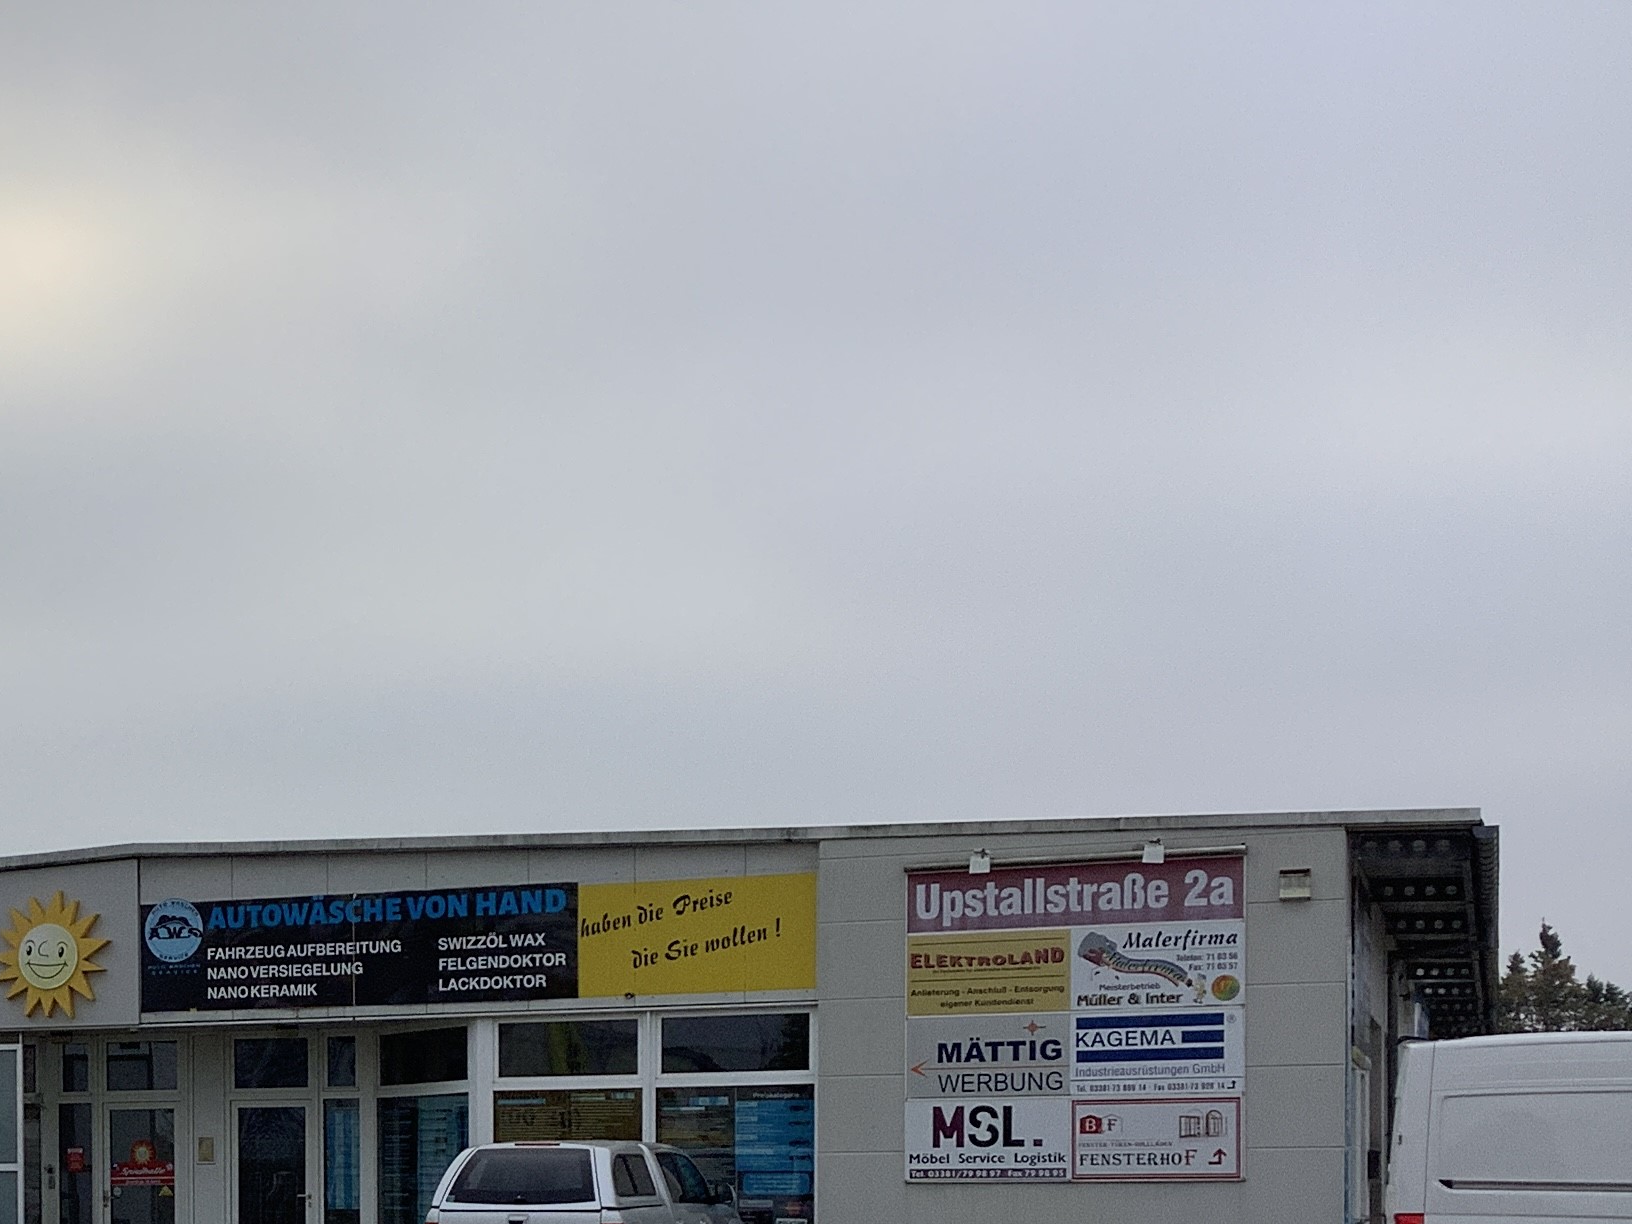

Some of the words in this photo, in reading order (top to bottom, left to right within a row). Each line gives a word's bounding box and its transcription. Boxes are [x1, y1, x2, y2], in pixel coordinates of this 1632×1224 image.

[915, 872, 1169, 927] Upstallstraße
[1184, 869, 1235, 908] 2a
[206, 895, 402, 930] AUTOWÄSCHE
[407, 893, 470, 921] VON
[475, 888, 568, 917] HAND
[580, 911, 632, 938] haben
[636, 904, 664, 925] die
[672, 888, 733, 917] Preise
[438, 932, 508, 951] SWIZZÖL
[509, 932, 547, 948] WAX
[631, 948, 660, 969] die
[664, 940, 699, 962] Sie
[704, 926, 769, 953] wollen
[1122, 929, 1238, 951] Malerfirma
[207, 944, 285, 961] FAHRZEUG
[286, 939, 402, 957] AUFBEREITUNG
[910, 947, 1065, 969] ELEKTROLAND
[207, 965, 250, 981] NANO
[250, 962, 364, 979] VERSIEGELUNG
[438, 953, 567, 972] FELGENDOKTOR
[207, 986, 250, 1000] NANO
[250, 983, 318, 998] KERAMIK
[438, 974, 548, 992] LACKDOKTOR
[910, 988, 960, 997] Anlieferung
[966, 986, 1007, 995] Anschluß
[1014, 985, 1065, 994] Entsorgung
[1099, 982, 1161, 991] Meisterbetrieb
[940, 1000, 972, 1009] eigener
[974, 998, 1035, 1007] Kundendienst
[1077, 993, 1123, 1006] Müller
[1128, 993, 1140, 1005] &
[1146, 992, 1184, 1005] Inter
[1076, 1029, 1177, 1048] KAGEMA
[937, 1037, 1063, 1063] MÄTTIG
[1075, 1064, 1189, 1078] Industrieausrüstungen
[1192, 1063, 1225, 1074] GmbH
[938, 1071, 1064, 1093] WERBUNG
[932, 1105, 1043, 1148] MSL.
[1085, 1118, 1097, 1132] B
[1107, 1119, 1118, 1132] F
[909, 1153, 950, 1164] Möbel
[958, 1153, 1006, 1164] Service
[1014, 1153, 1066, 1166] Logistik
[1079, 1149, 1198, 1166] FENSTERHOF
